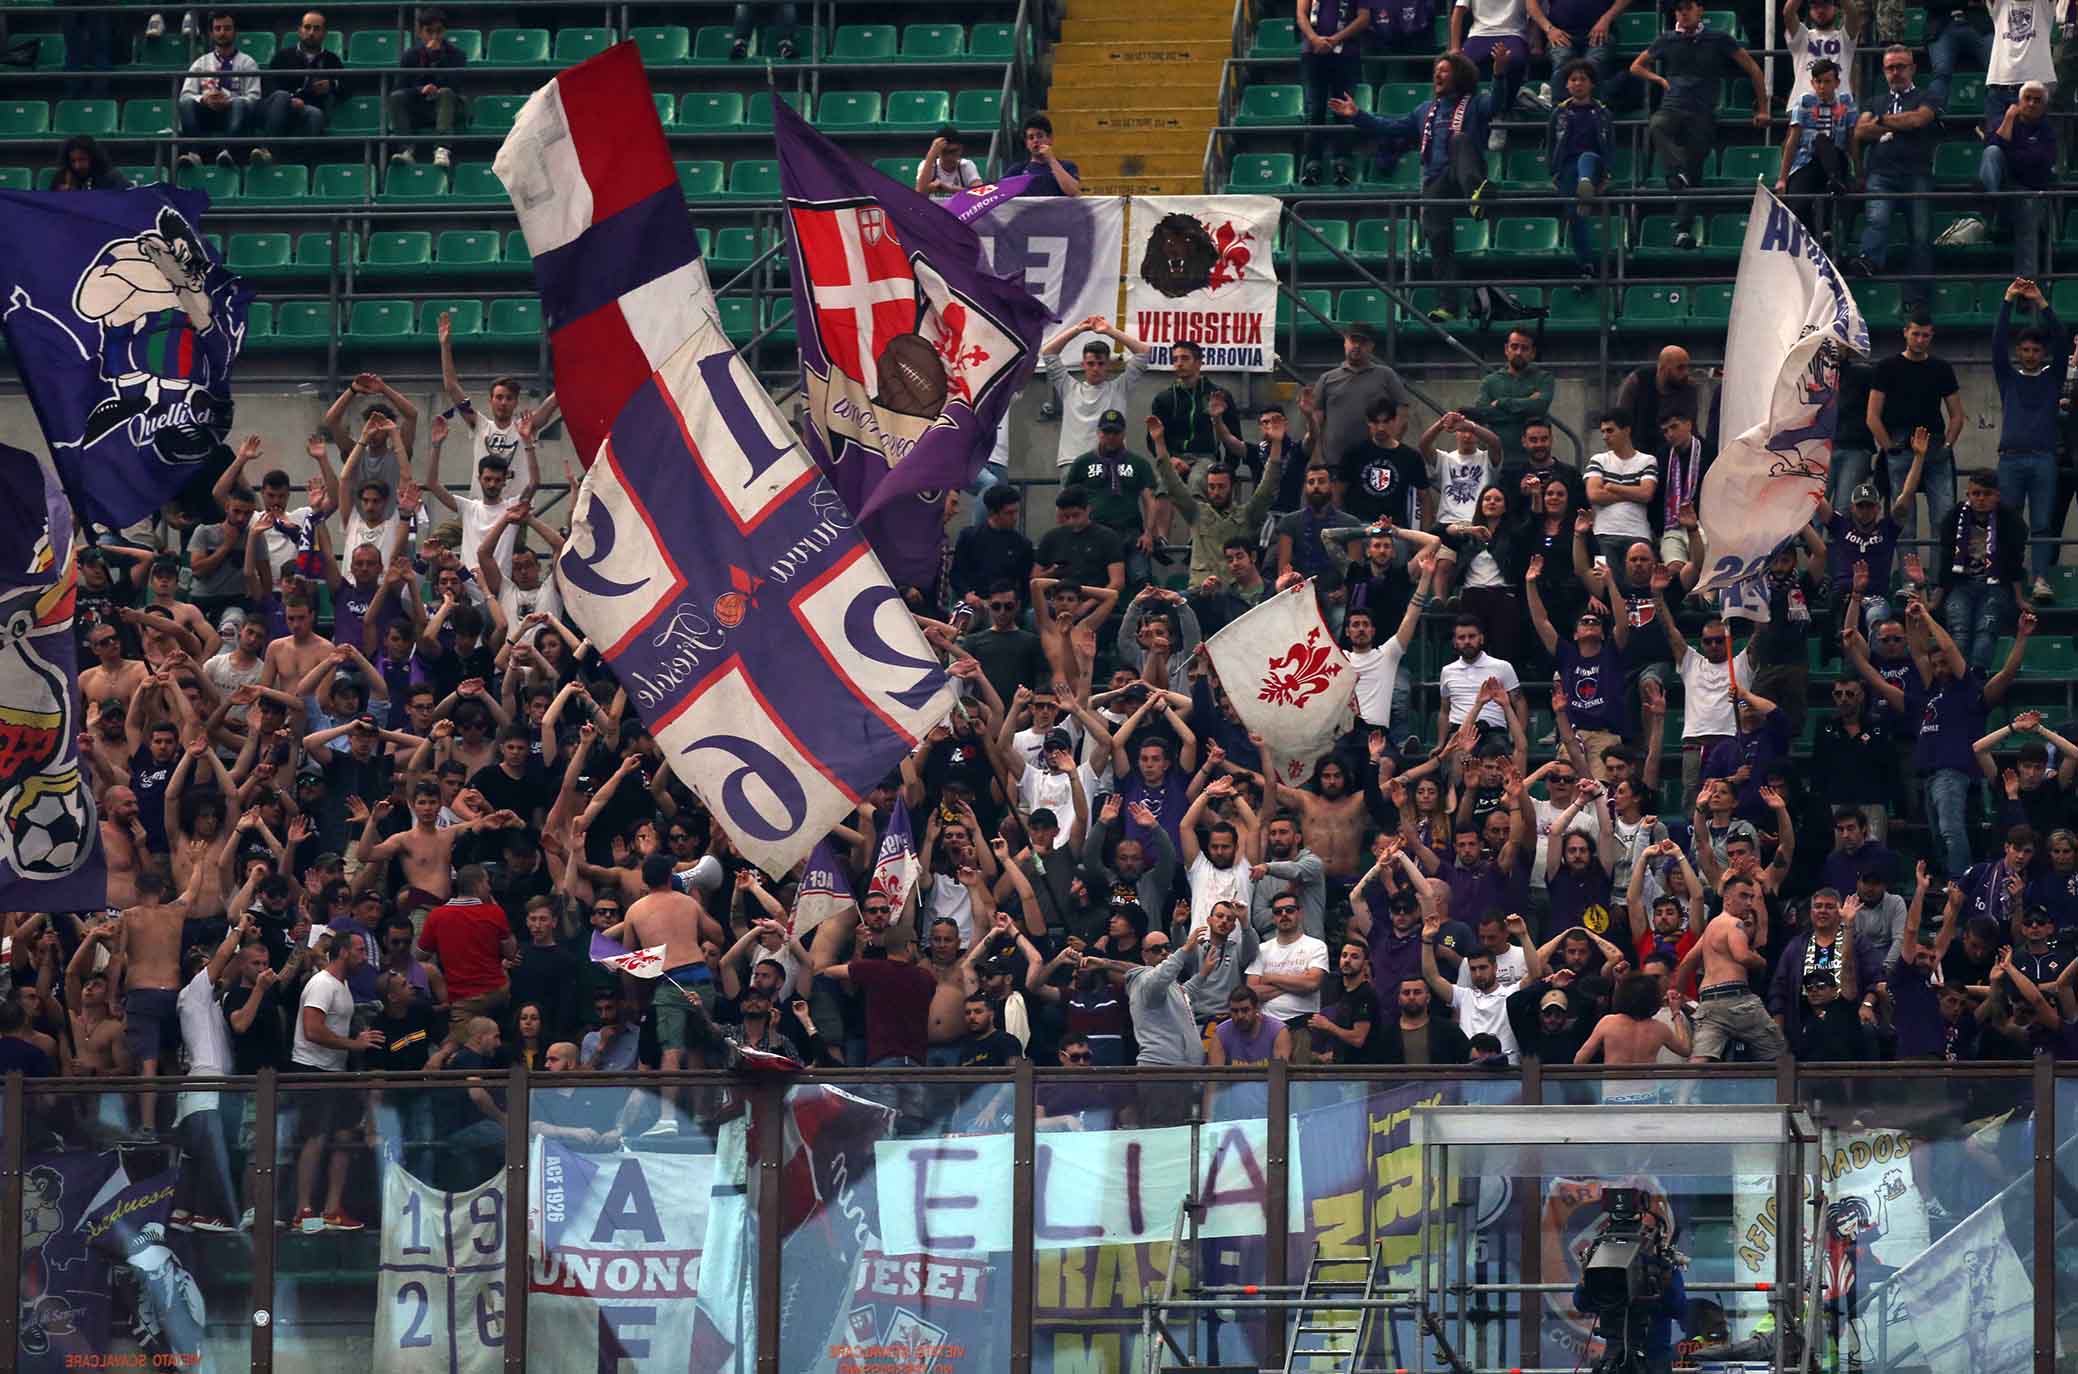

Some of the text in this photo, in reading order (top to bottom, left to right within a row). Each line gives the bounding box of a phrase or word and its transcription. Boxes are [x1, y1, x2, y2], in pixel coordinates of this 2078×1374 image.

[1138, 311, 1263, 344] VIEUSSEUX
[1200, 346, 1263, 366] ERROVIA
[128, 402, 190, 447] Quelli
[546, 1155, 566, 1223] ACF 1926
[589, 1158, 666, 1242] A
